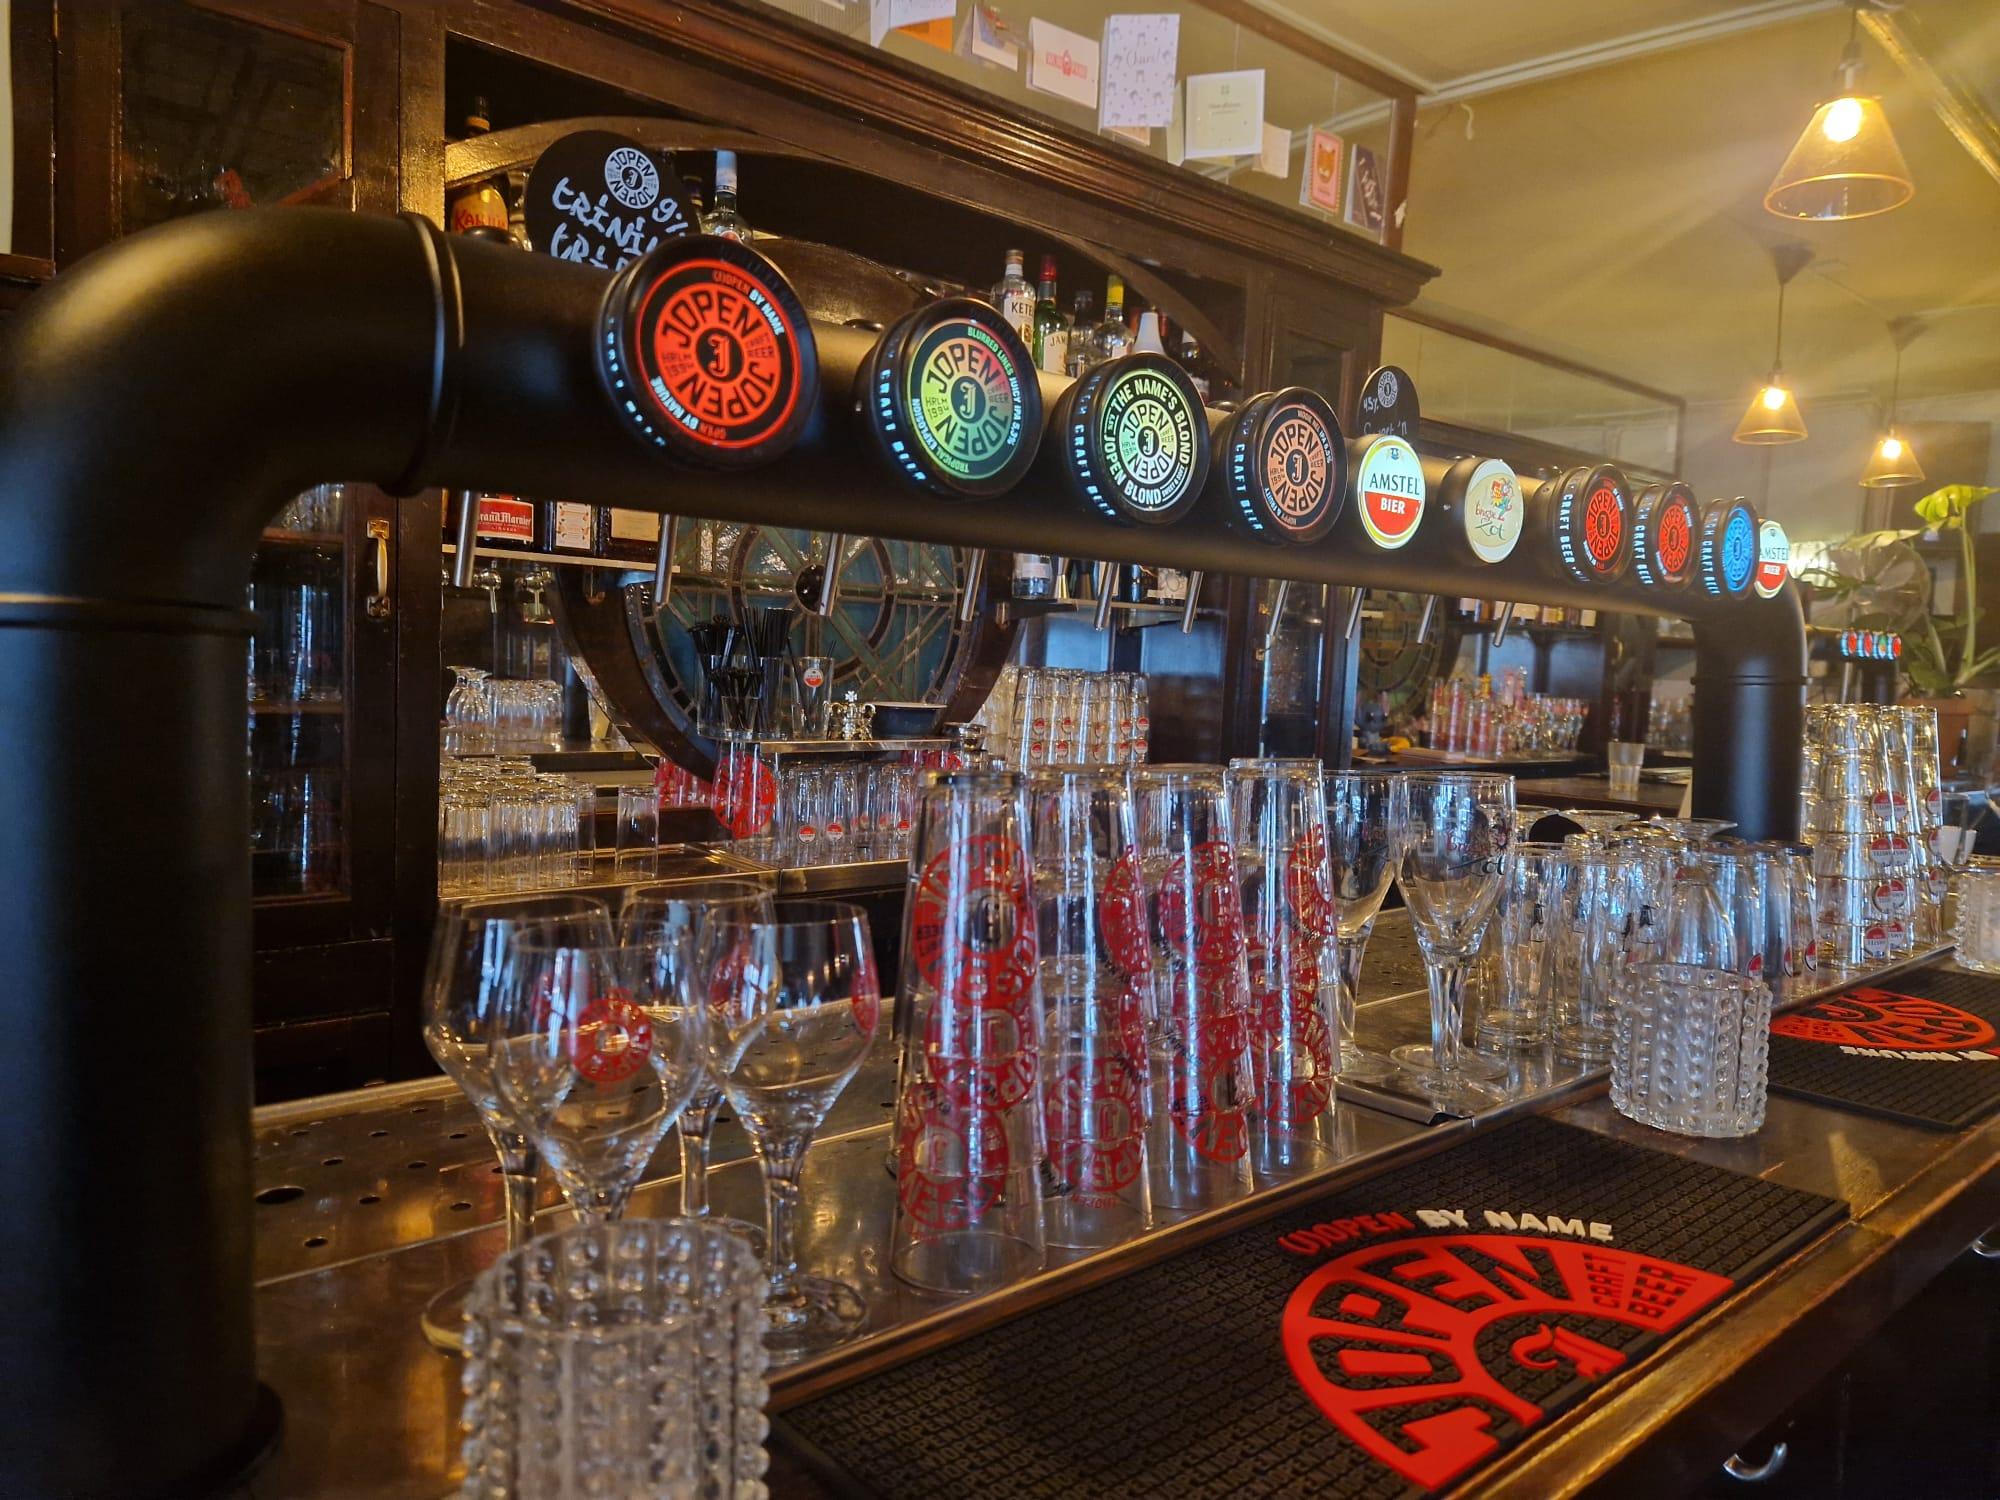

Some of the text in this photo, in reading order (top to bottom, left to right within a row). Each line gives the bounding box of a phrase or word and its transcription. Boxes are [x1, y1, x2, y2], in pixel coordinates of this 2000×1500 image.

[611, 150, 655, 177] JOPEN
[609, 181, 654, 206] JOPEN
[662, 289, 762, 349] JOPEN
[749, 288, 765, 305] BY
[761, 302, 785, 336] NAME
[967, 326, 999, 353] BLURRED
[926, 343, 999, 394] JOPEN
[997, 349, 1014, 379] LINES
[651, 375, 683, 419] NATURE
[677, 362, 775, 419] JOPEN
[925, 396, 949, 407] HRLM
[1009, 376, 1022, 403] JUICY
[683, 415, 699, 430] BY
[927, 405, 950, 420] 1994
[1013, 403, 1022, 421] IPA
[1111, 378, 1191, 466] THE NAME'S BLOND
[1122, 404, 1170, 440] JOPEN
[911, 398, 970, 473] TROPICAL EXPLOSION
[935, 405, 1009, 457] JOPEN
[1270, 423, 1319, 466] JOPEN
[1103, 434, 1162, 505] JOPEN BLOND
[1127, 444, 1175, 481] JOPEN
[1234, 443, 1247, 492] CRAFT
[1275, 470, 1324, 512] JOPEN
[1369, 472, 1421, 496] AMSTEL
[480, 511, 502, 525] rand
[1380, 497, 1407, 514] BIER
[1588, 493, 1617, 521] JOPEN
[1559, 494, 1576, 563] CRAFT BEER
[1633, 525, 1646, 560] CRAFT
[1416, 1209, 1469, 1229] BY
[1483, 1209, 1614, 1242] NAME
[1582, 1251, 1627, 1309] CRAFT
[1626, 1262, 1698, 1320] BEER
[1307, 1243, 1576, 1457] JOPEN
